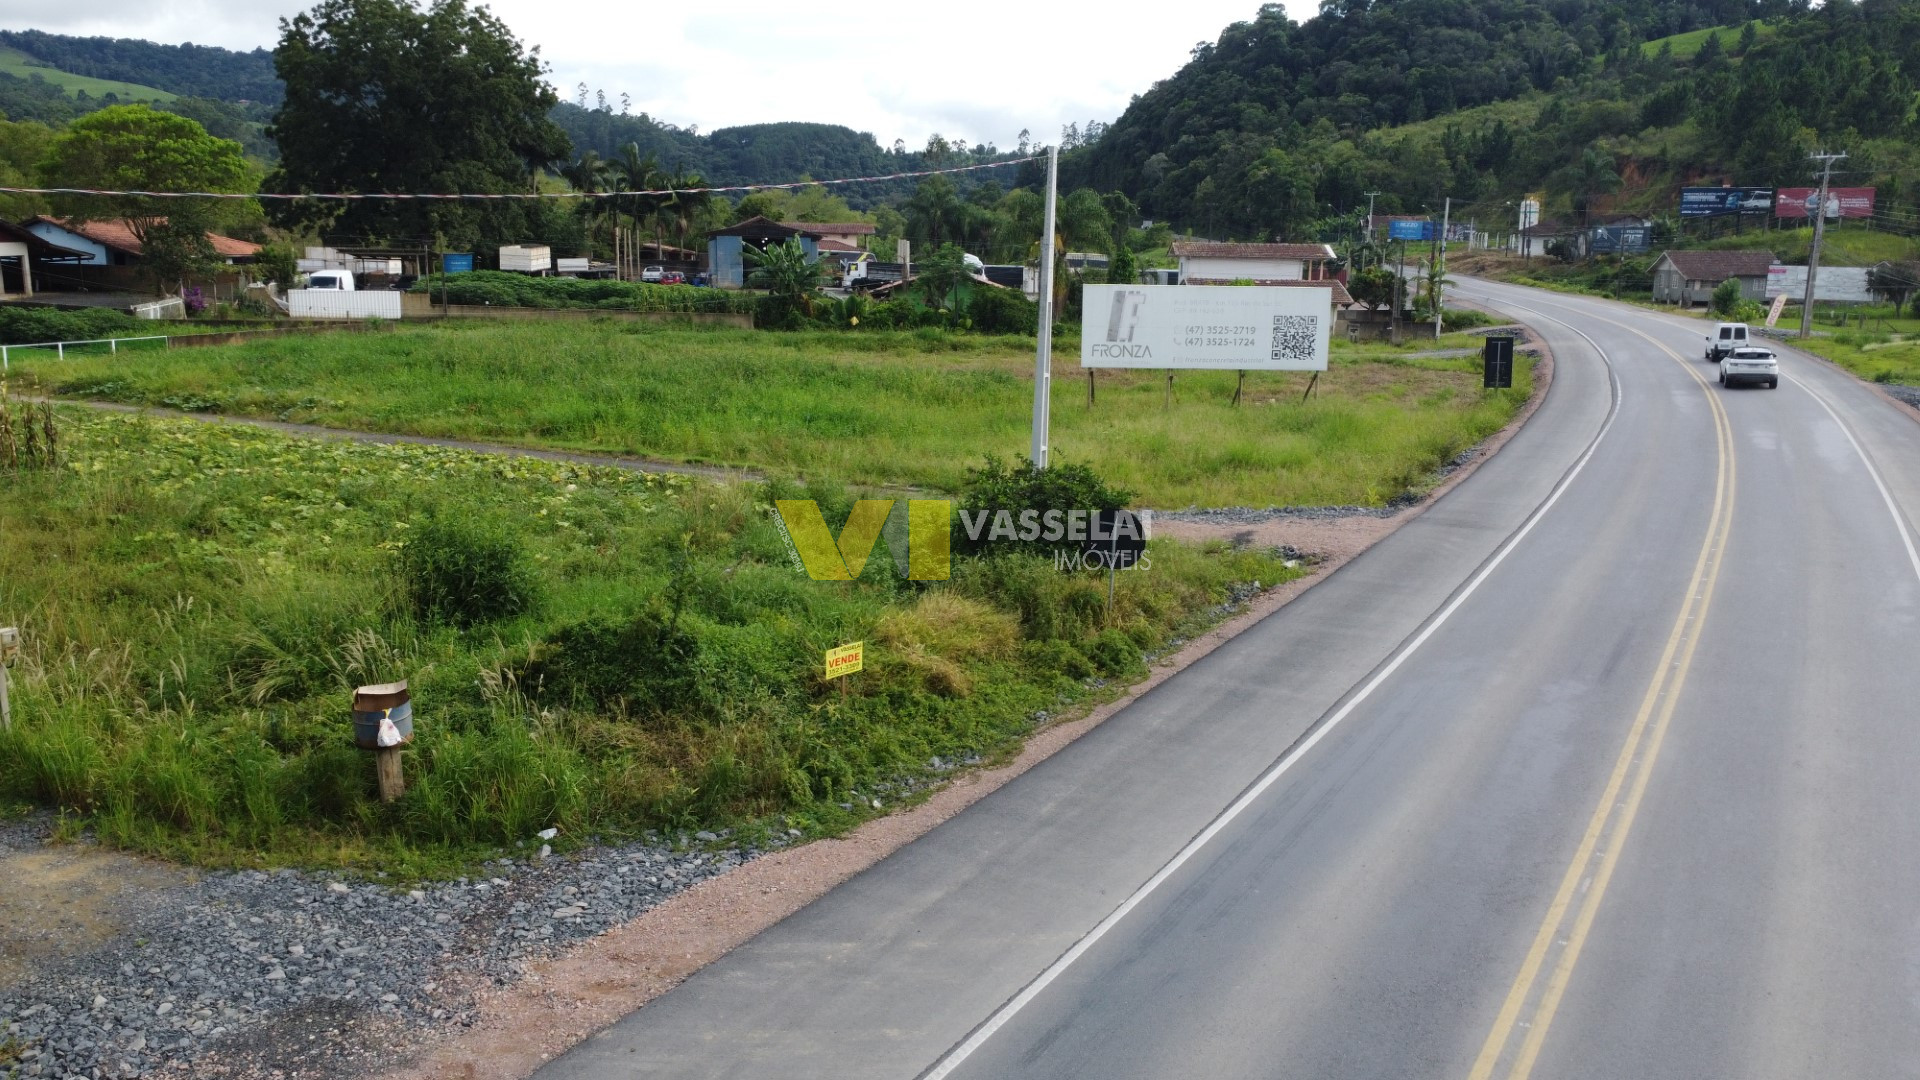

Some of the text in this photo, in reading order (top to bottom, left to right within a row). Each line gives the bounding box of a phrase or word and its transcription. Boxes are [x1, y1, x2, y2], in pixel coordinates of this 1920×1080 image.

[1185, 325, 1256, 335] (47) 3525-2719
[1184, 337, 1255, 347] (47) 3525-1724
[1091, 344, 1153, 358] FRONZA
[828, 652, 861, 669] VENDE
